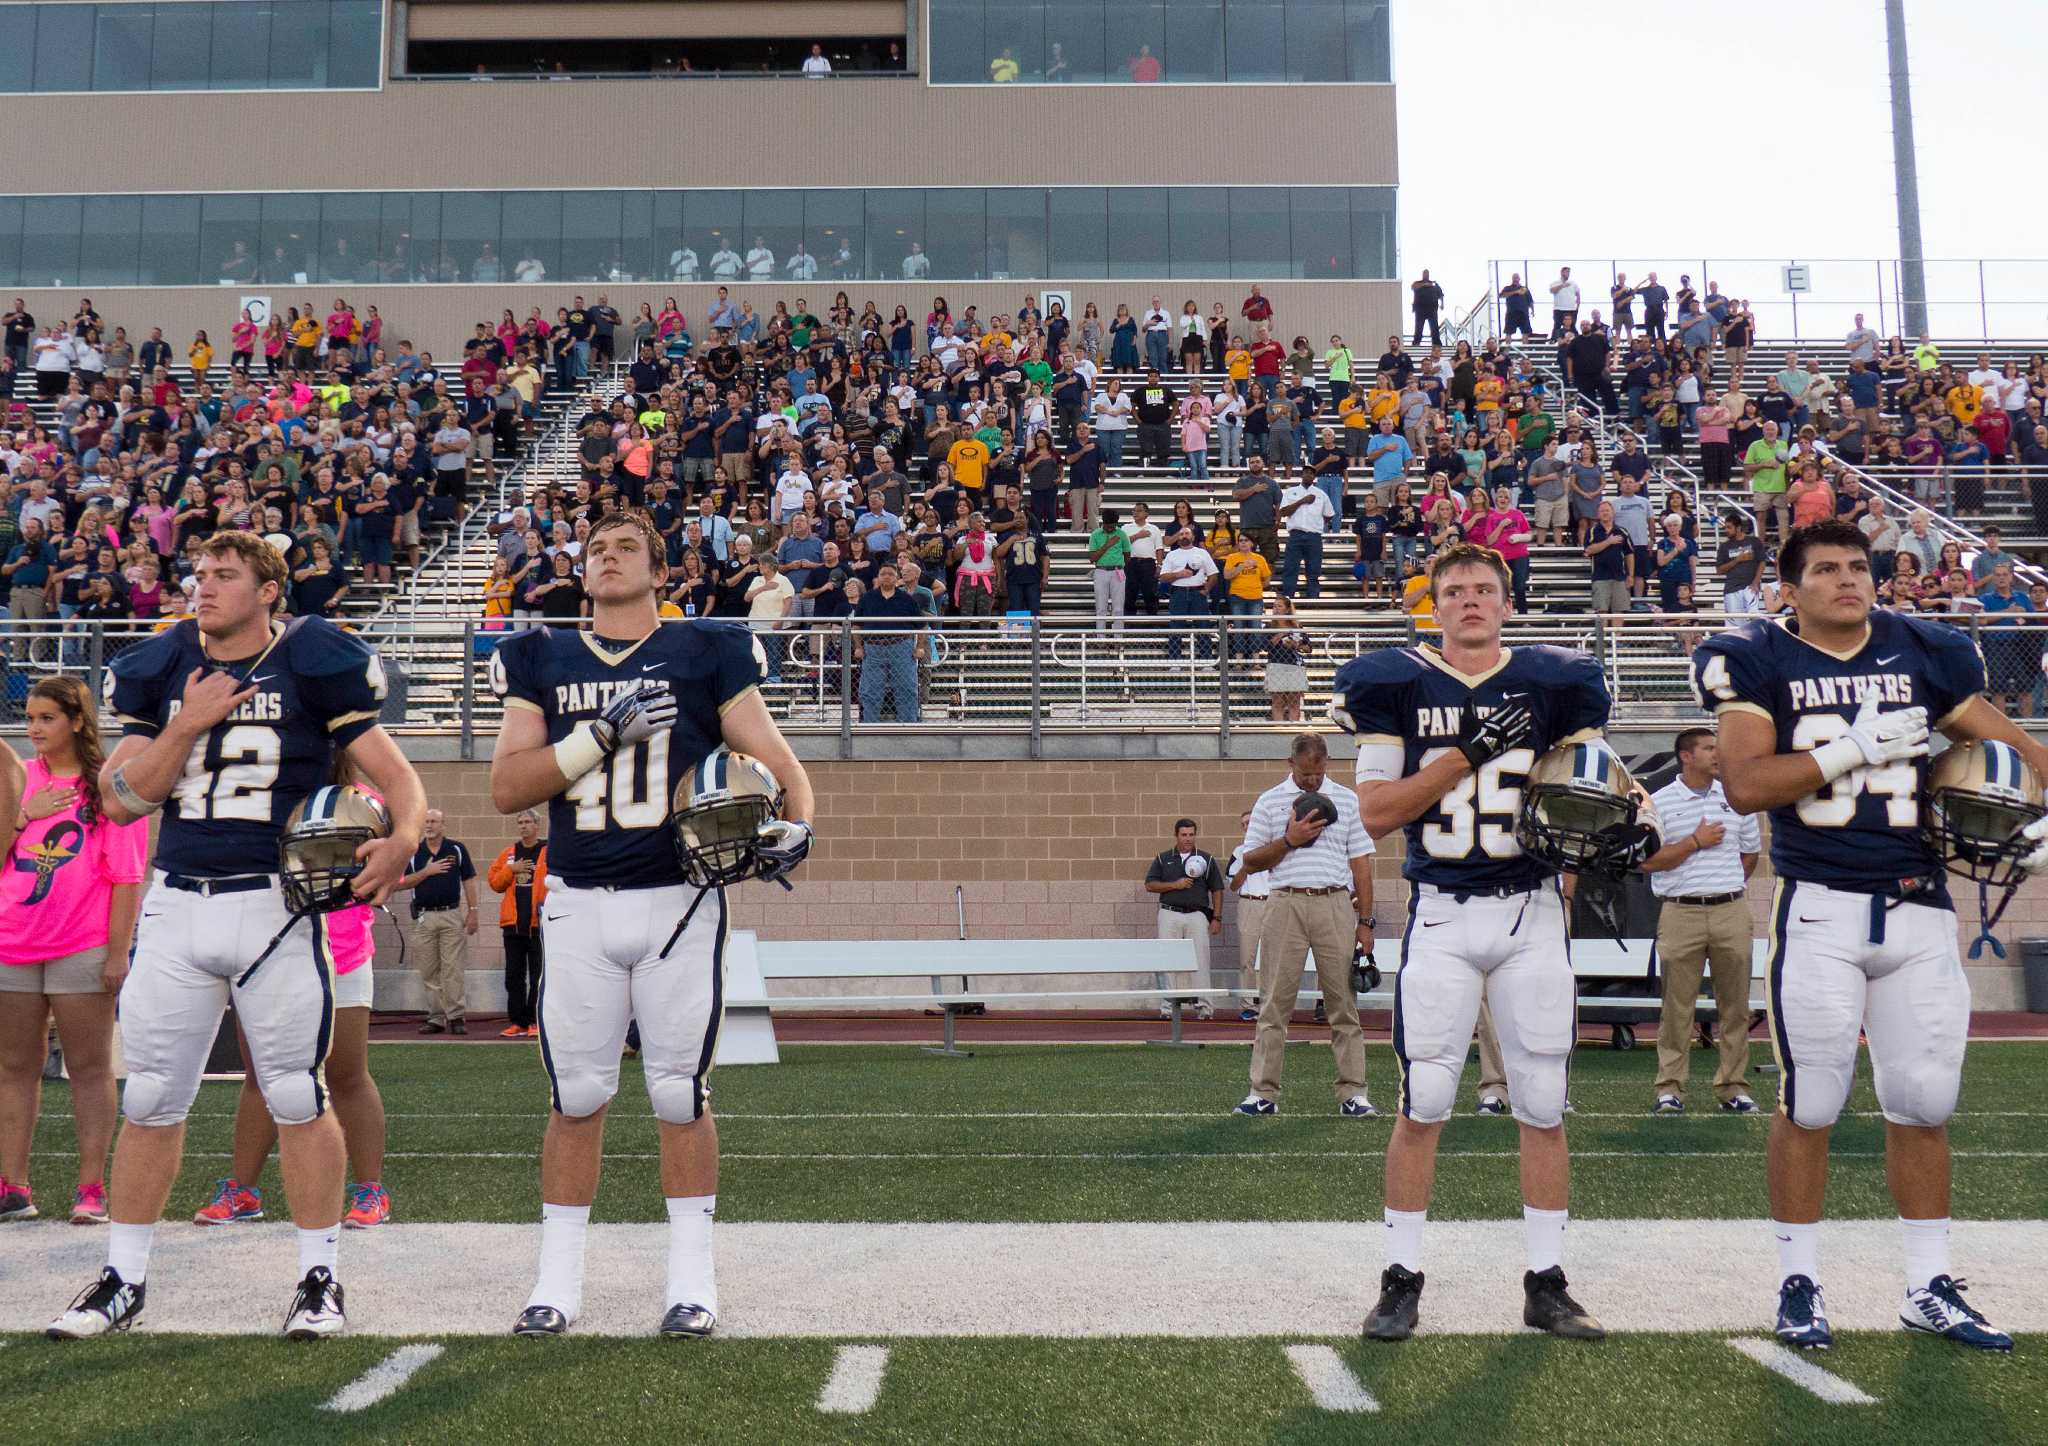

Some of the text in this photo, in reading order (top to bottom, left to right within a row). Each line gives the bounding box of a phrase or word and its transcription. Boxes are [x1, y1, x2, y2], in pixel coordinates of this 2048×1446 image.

[1787, 268, 1806, 290] E
[246, 300, 265, 323] C
[1046, 294, 1066, 319] D
[168, 693, 282, 724] PERS
[556, 680, 670, 714] PANT
[172, 725, 282, 822] 42
[565, 719, 671, 831] 40
[1418, 746, 1537, 859] 35
